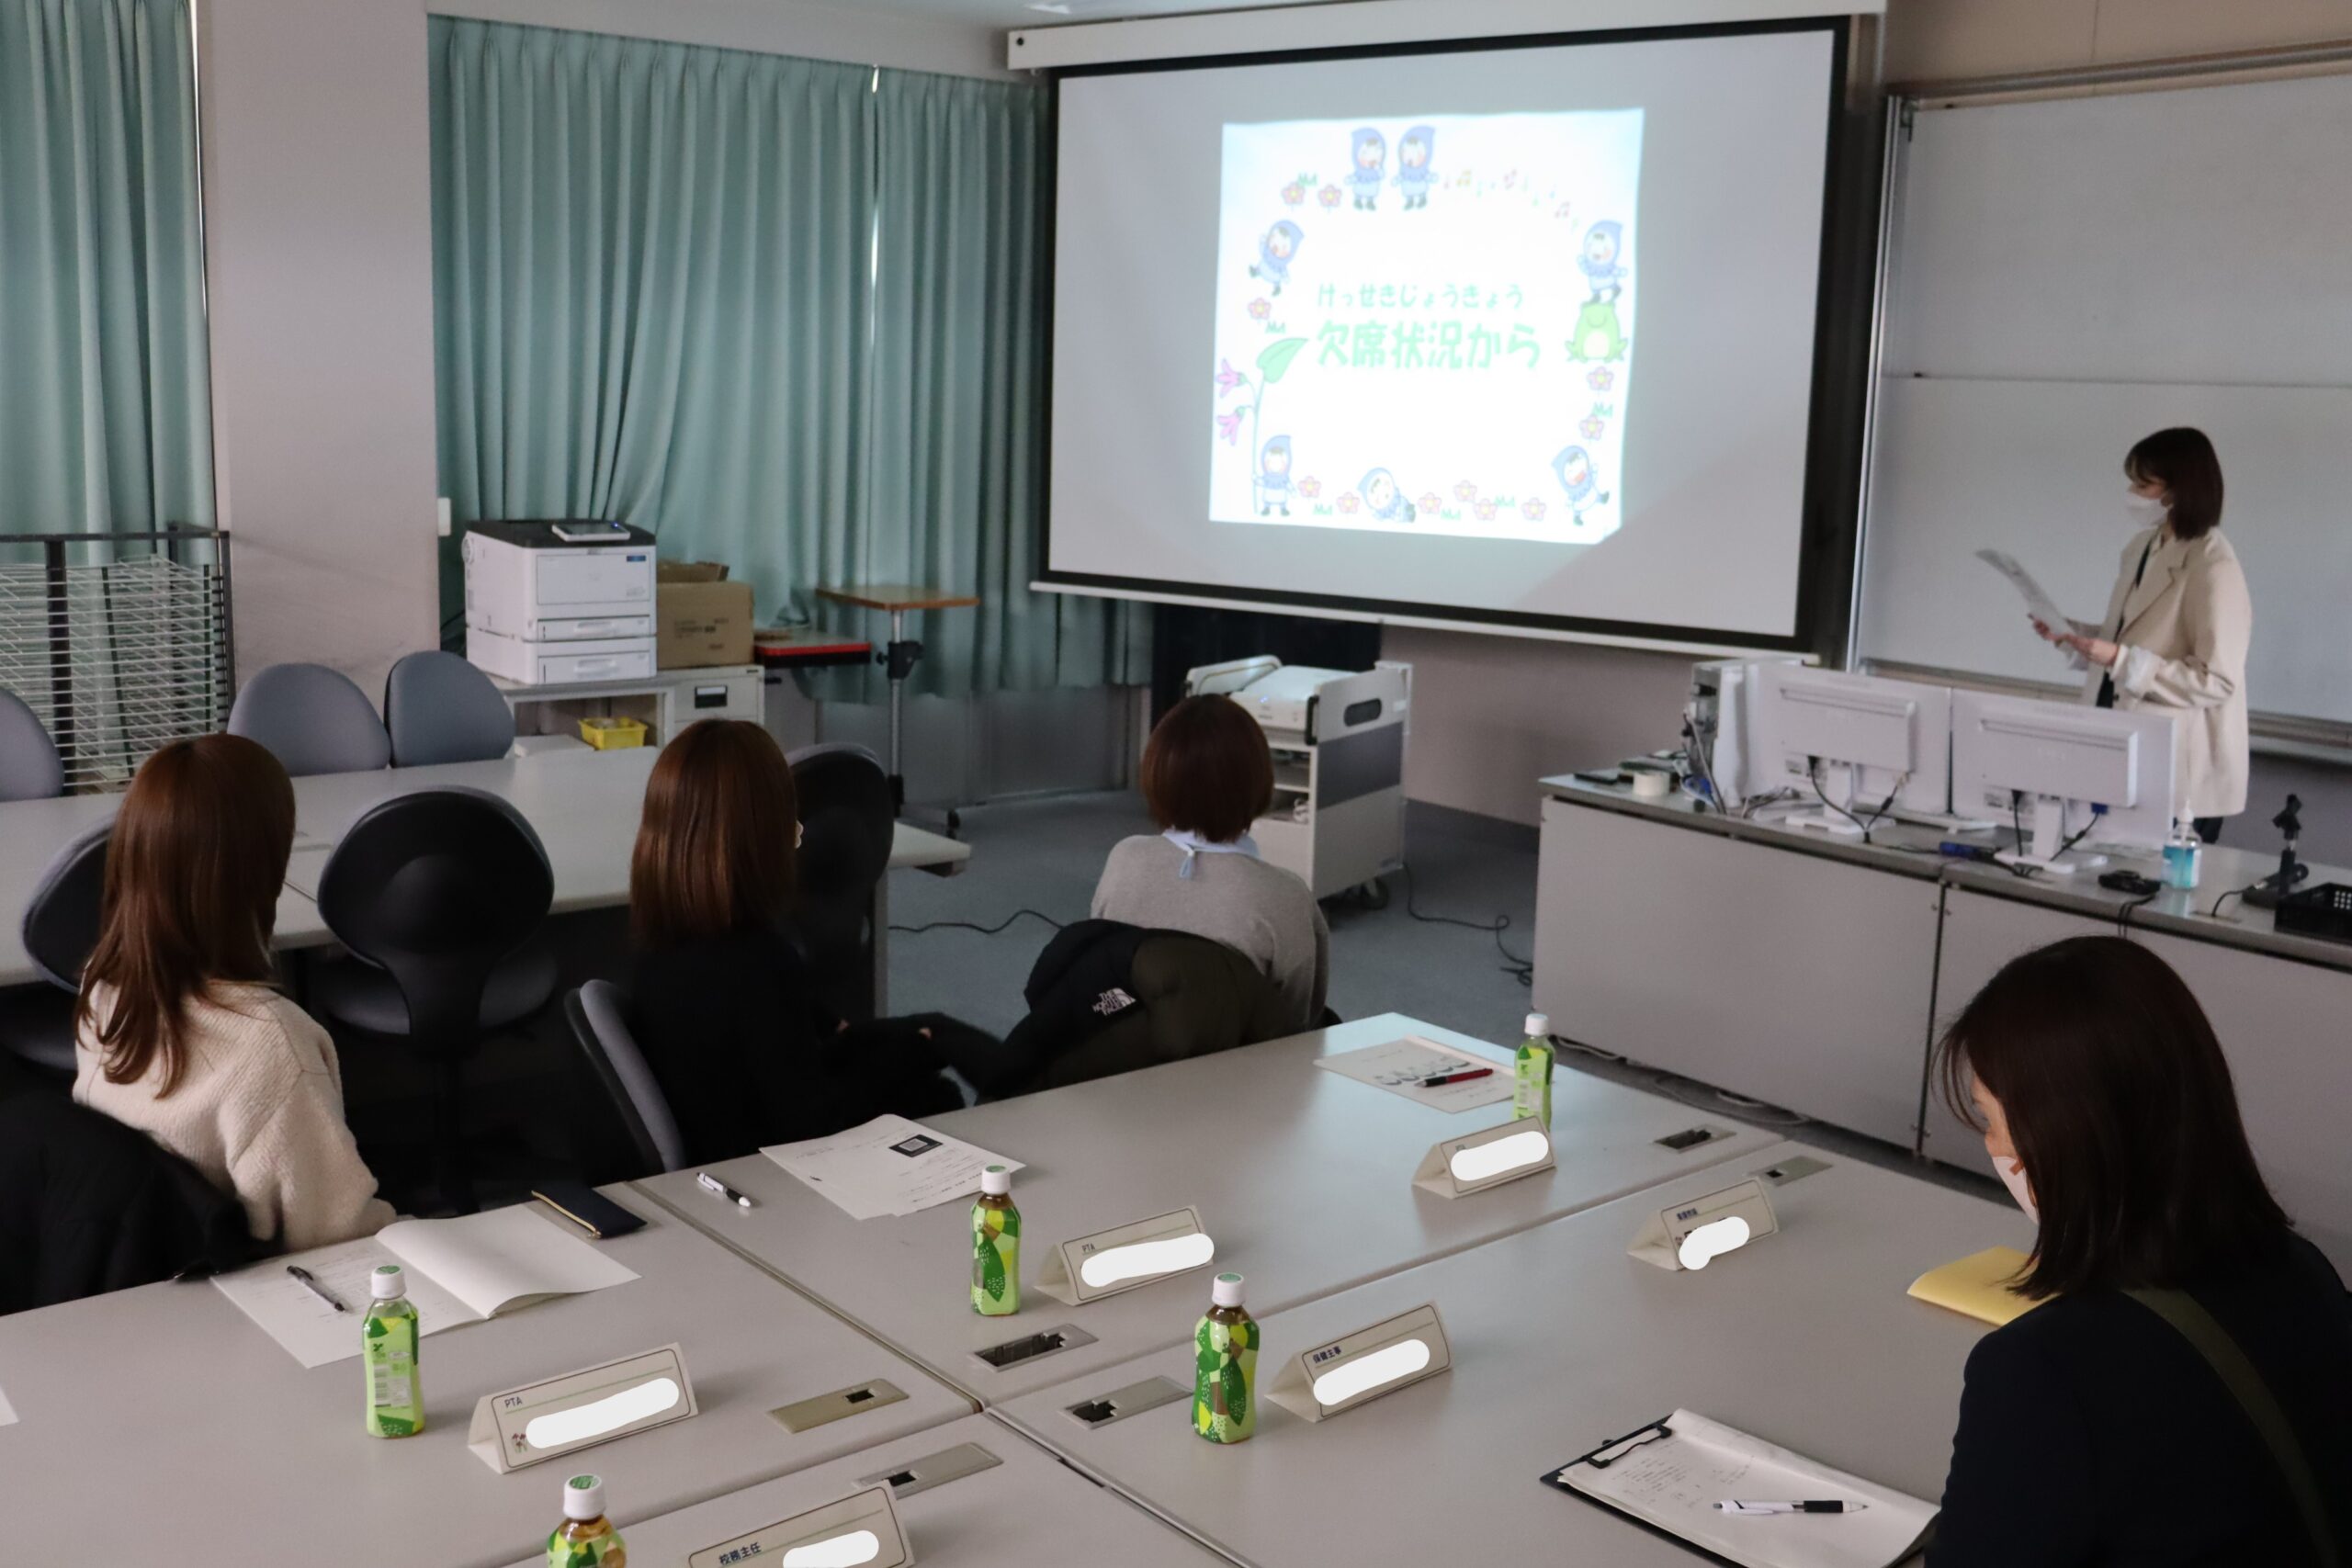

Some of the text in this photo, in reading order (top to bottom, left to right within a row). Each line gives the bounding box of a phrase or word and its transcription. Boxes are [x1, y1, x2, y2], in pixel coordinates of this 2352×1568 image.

[1317, 282, 1523, 309] けっせきじょうきょう
[1317, 319, 1541, 369] 欠席状況から
[1081, 1243, 1096, 1253] PTA
[504, 1396, 523, 1408] PTA
